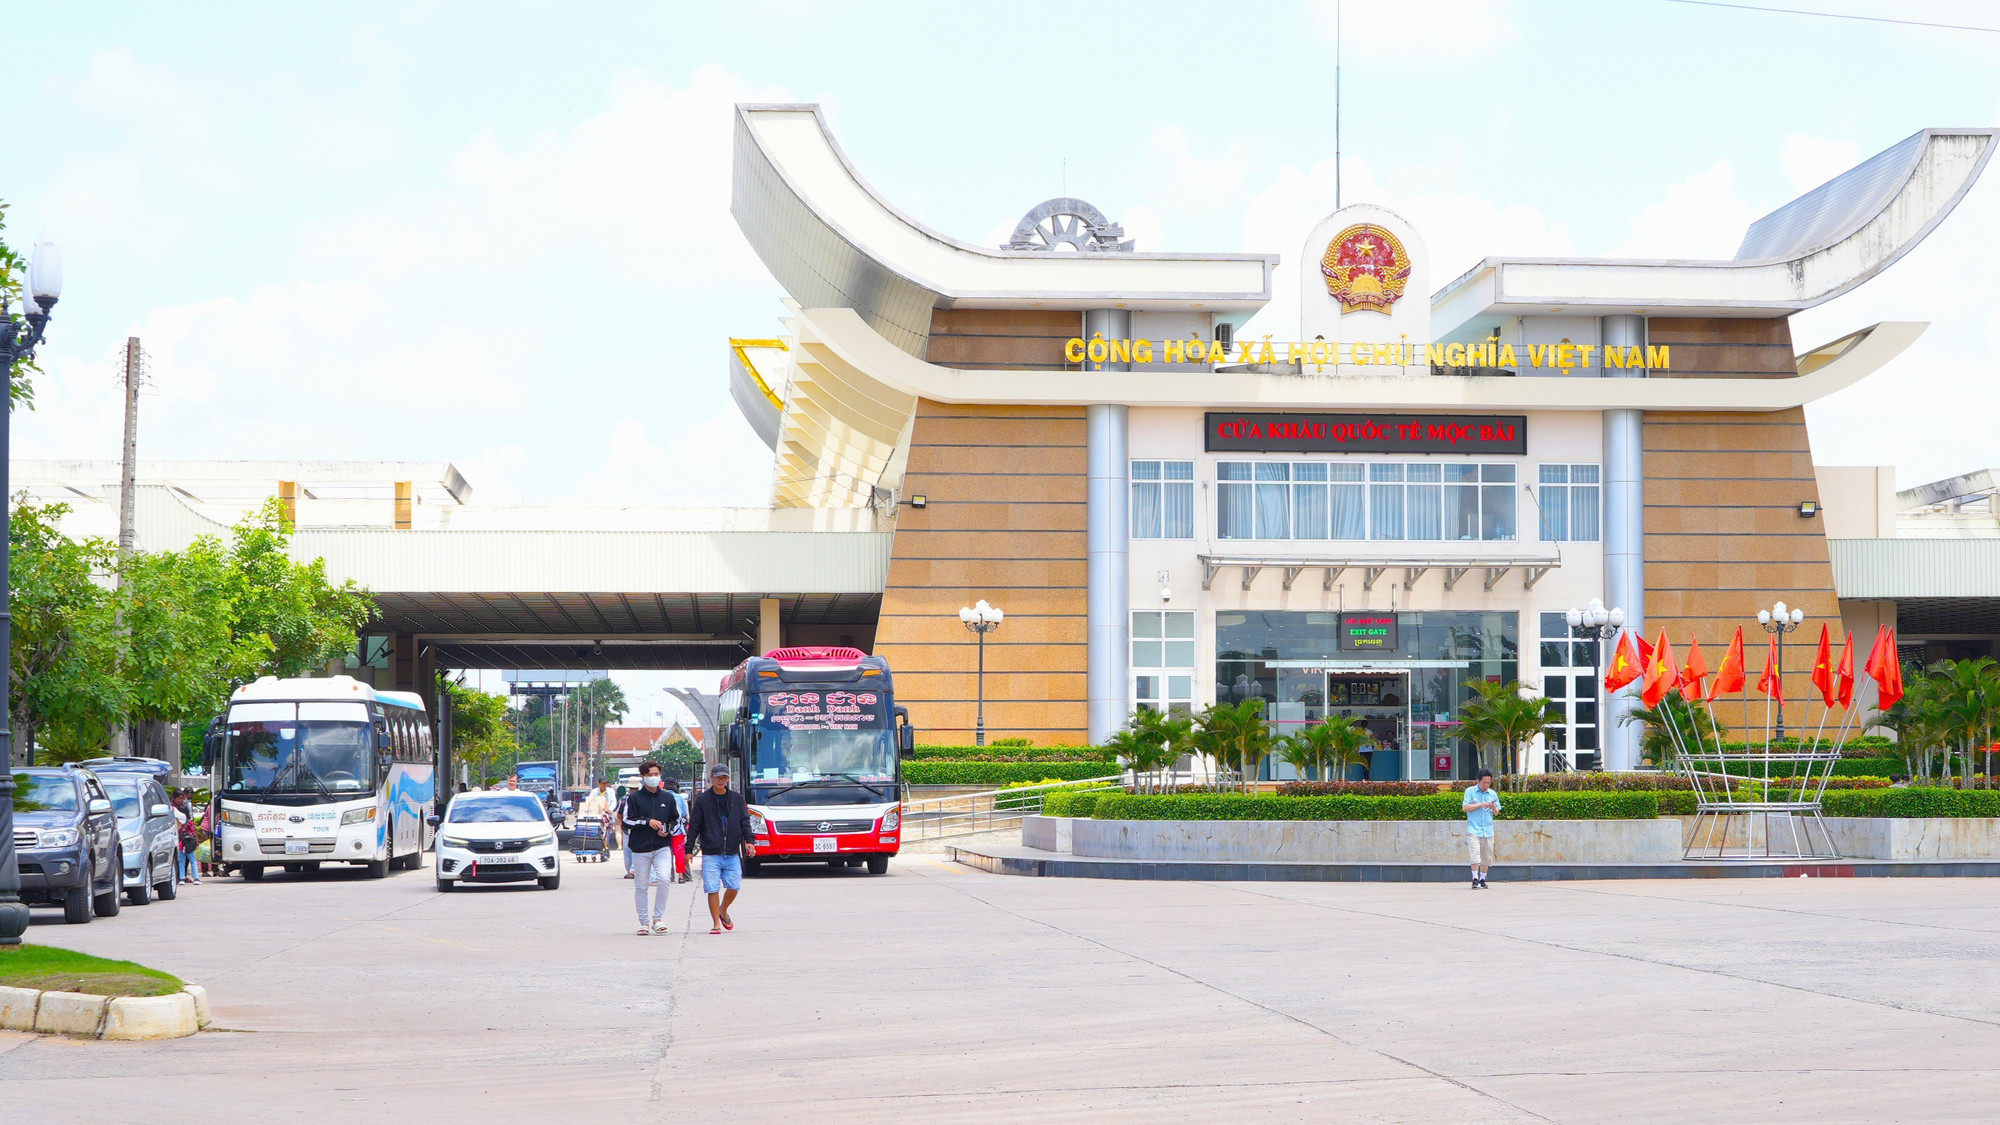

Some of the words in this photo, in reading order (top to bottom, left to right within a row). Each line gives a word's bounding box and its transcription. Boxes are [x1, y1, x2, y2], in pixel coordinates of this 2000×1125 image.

[1065, 332, 1152, 370] CỘNG
[1164, 332, 1225, 365] HÒA
[1237, 334, 1276, 366] XÃ
[1288, 334, 1338, 373] HỘI
[1350, 334, 1413, 367] CHỦ
[1424, 336, 1517, 368] NGHĨA
[1527, 338, 1595, 375] VIỆT
[1604, 345, 1670, 368] NAM
[1217, 418, 1262, 439] CỬA
[1331, 419, 1391, 443] QUỐC
[1396, 420, 1422, 440] TẾ
[1427, 422, 1475, 444] MỘC
[1480, 421, 1515, 441] BÀI
[1350, 628, 1367, 636] EXIT
[1368, 628, 1388, 636] GATE
[786, 705, 821, 713] Danh
[827, 704, 861, 713] Danh
